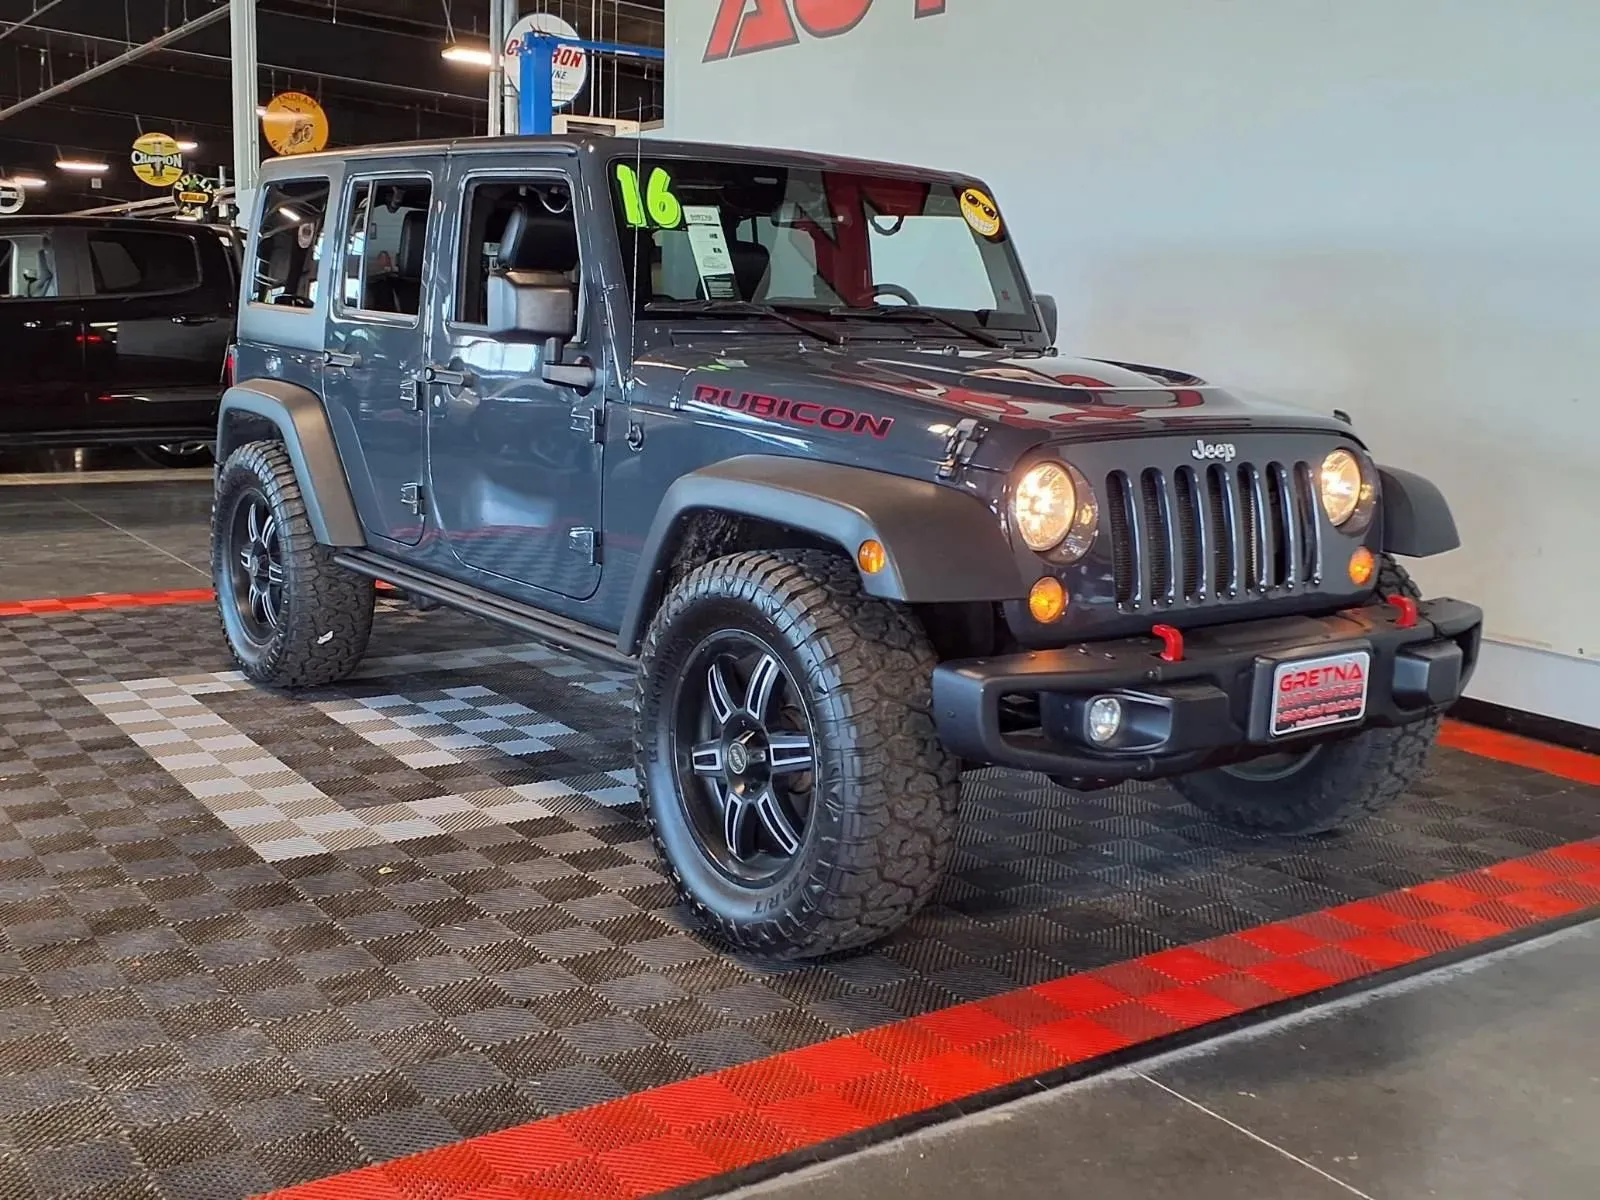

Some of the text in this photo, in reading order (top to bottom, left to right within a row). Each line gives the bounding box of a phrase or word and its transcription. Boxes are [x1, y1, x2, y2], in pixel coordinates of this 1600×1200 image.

[617, 164, 681, 228] 16
[693, 384, 895, 440] RUBICON
[1191, 439, 1236, 462] Jeep
[1280, 663, 1362, 692] GRETNA
